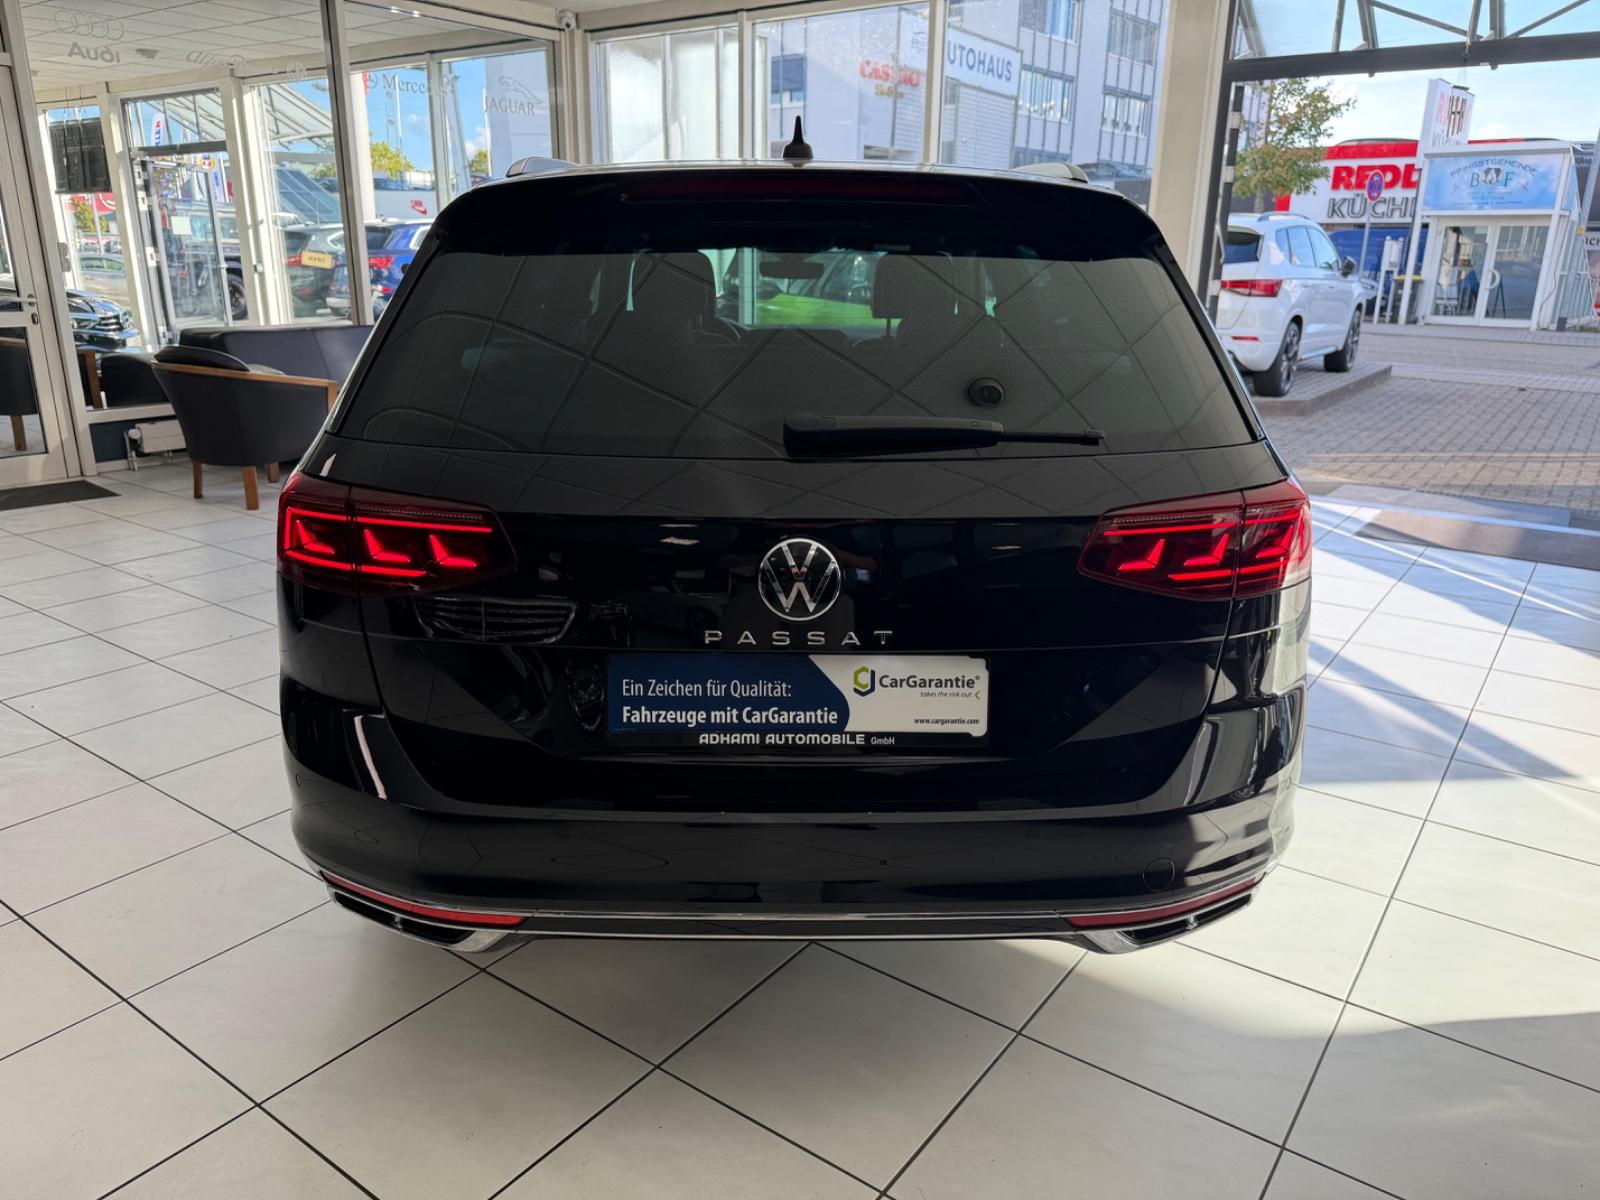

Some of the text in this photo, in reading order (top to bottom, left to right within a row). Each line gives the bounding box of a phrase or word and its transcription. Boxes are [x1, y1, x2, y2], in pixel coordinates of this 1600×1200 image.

[67, 41, 121, 63] Audi
[484, 96, 536, 116] JAGUAR
[704, 630, 894, 646] PASSAT
[622, 679, 792, 698] Ein Zeichen für Qualität:
[622, 706, 838, 727] Fahrzeuge mit CarGarantie
[914, 718, 980, 726] www.cargarantie.com
[699, 733, 895, 745] ADHAMI AUTOMOBILE GmbH
